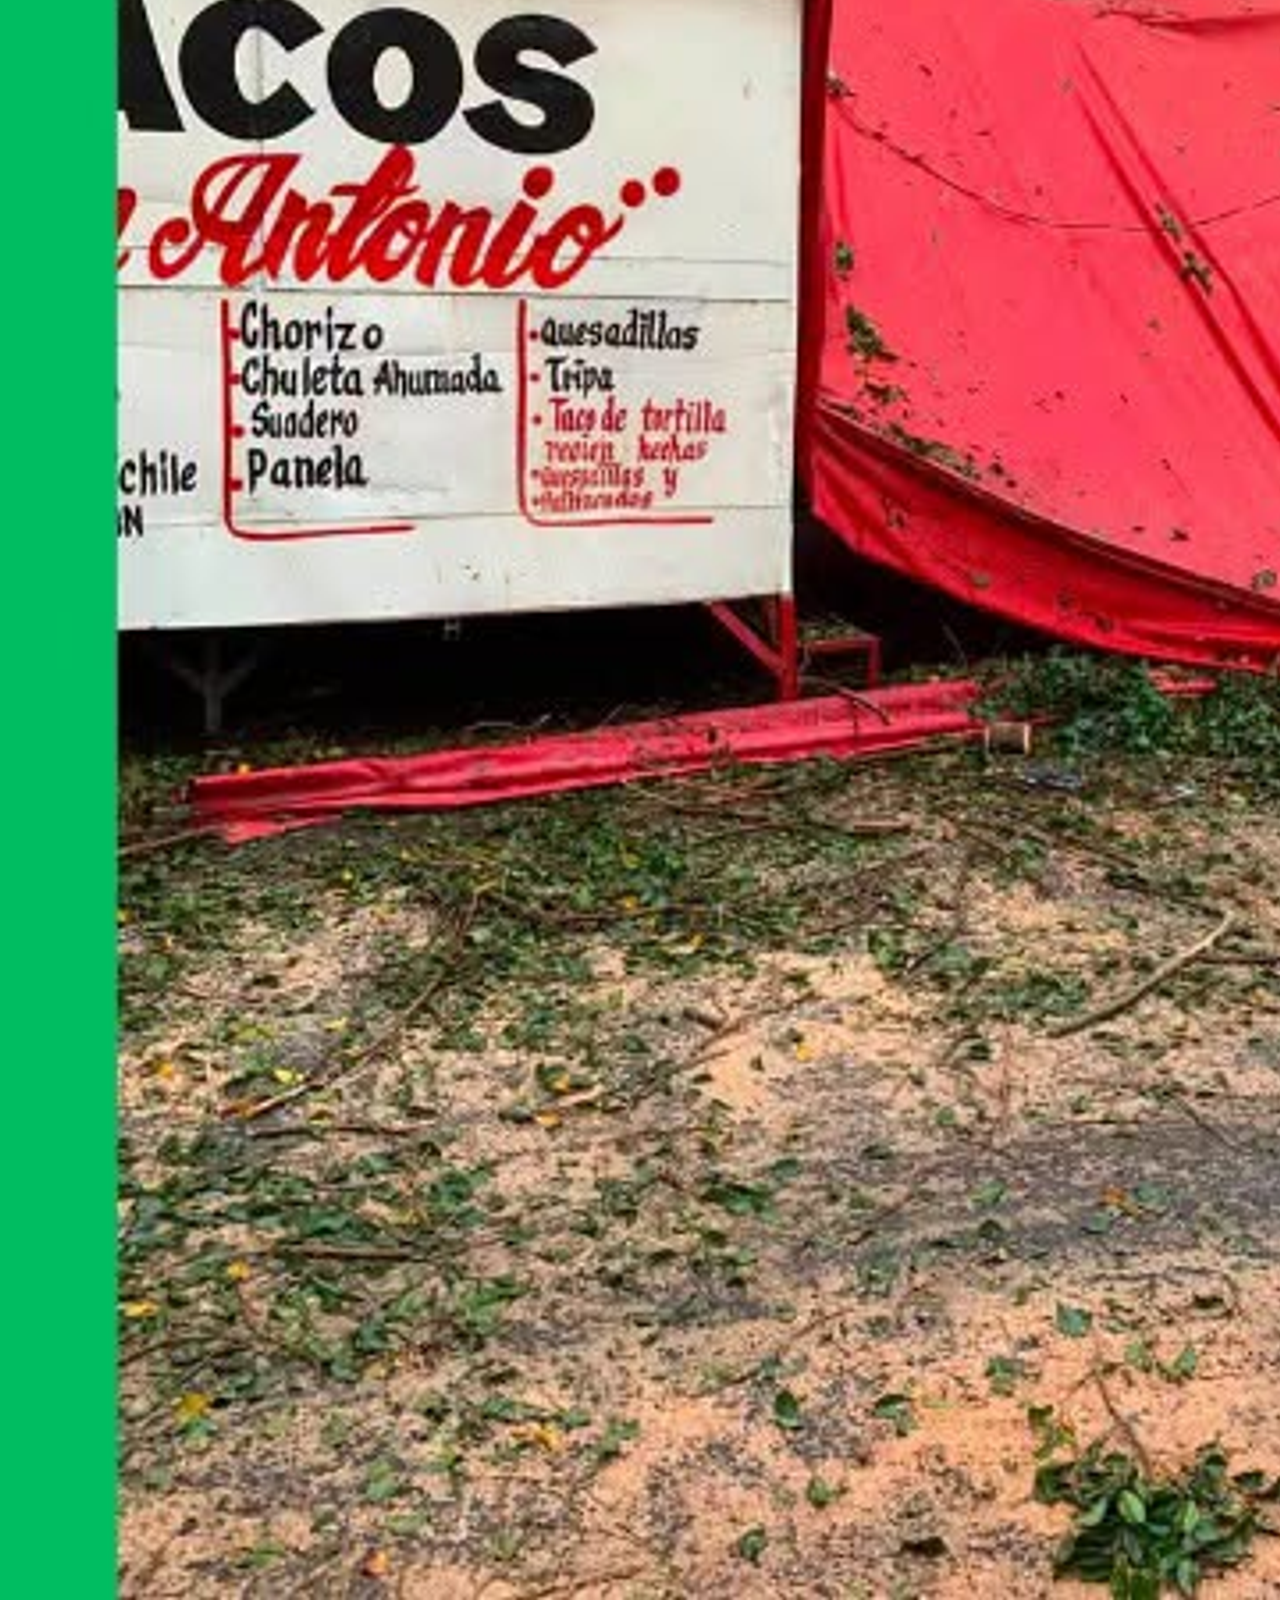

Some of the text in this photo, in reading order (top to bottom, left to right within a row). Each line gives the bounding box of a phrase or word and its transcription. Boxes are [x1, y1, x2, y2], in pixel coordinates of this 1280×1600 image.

[240, 301, 384, 351] Chorizo
[240, 352, 503, 398] Chuleta Ahumada
[545, 356, 616, 398] Tripa
[251, 399, 359, 440] Suadero
[641, 397, 727, 434] tortilla
[247, 444, 369, 492] Panela
